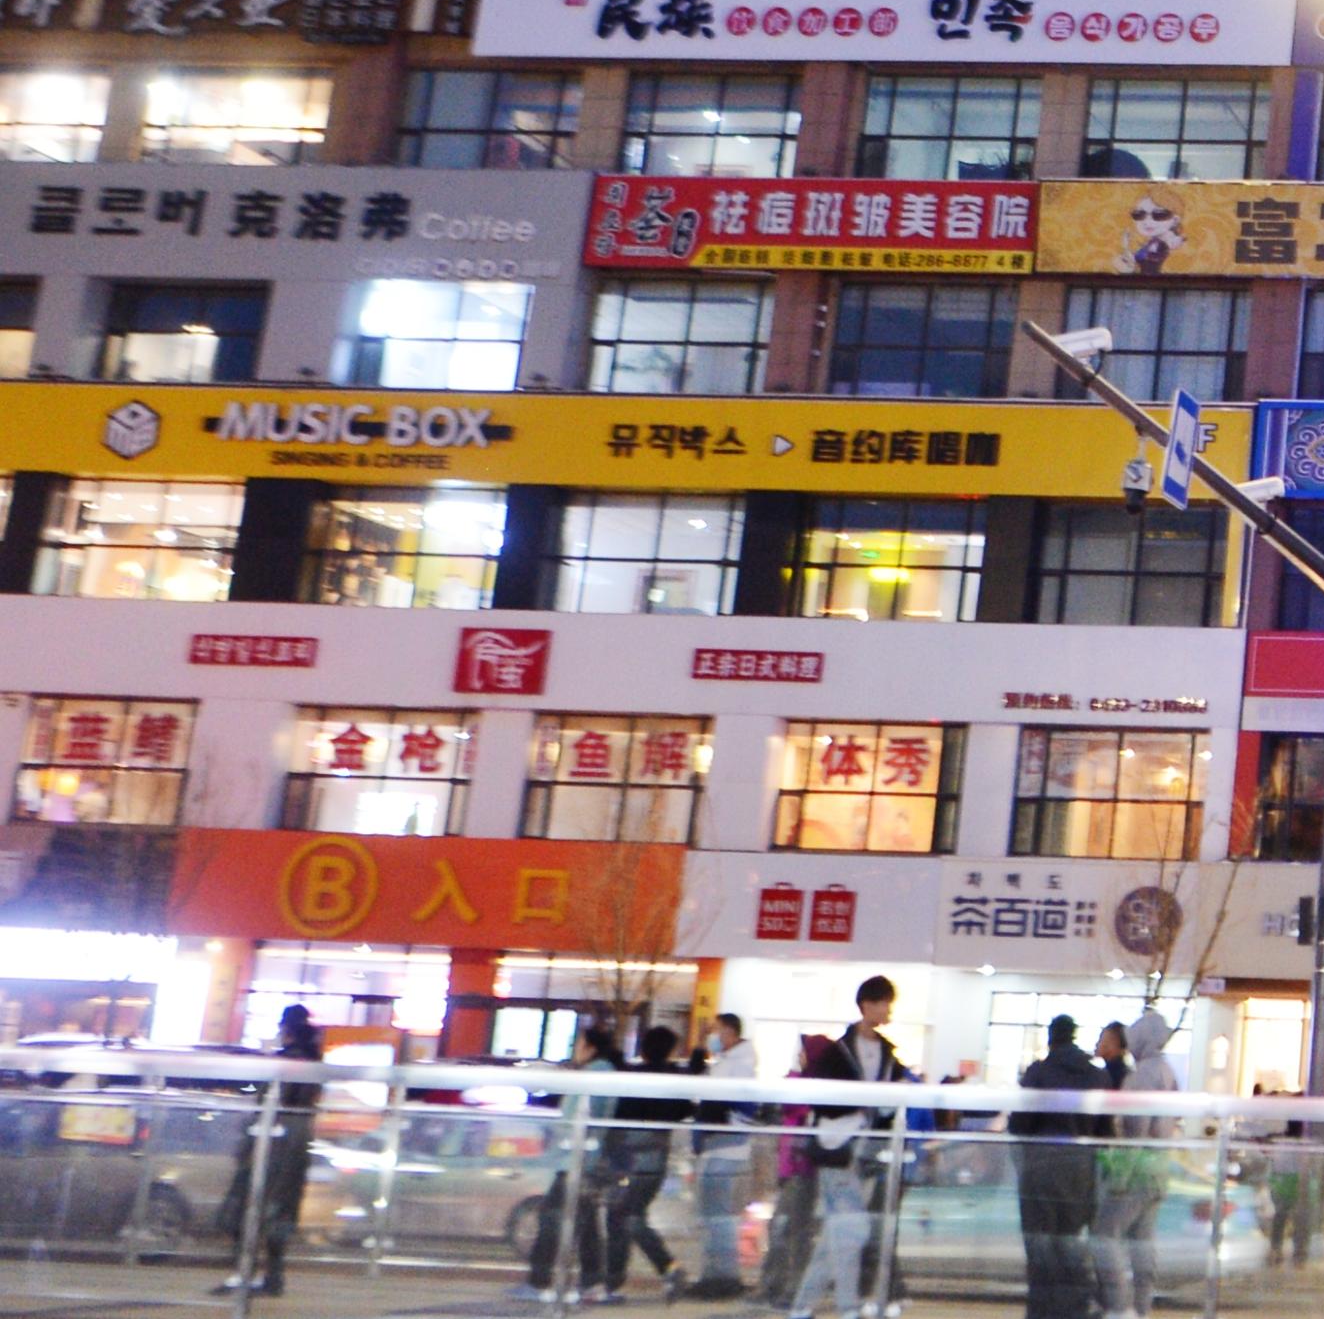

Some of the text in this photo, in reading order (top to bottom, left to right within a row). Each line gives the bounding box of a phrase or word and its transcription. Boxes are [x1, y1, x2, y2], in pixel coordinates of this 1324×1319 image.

[227, 189, 413, 243] 克洛弗
[217, 400, 494, 448] MUSIC BOX
[605, 423, 747, 460] 뮤직박스
[300, 854, 572, 926] B 入口
[950, 895, 1069, 940] 茶百道
